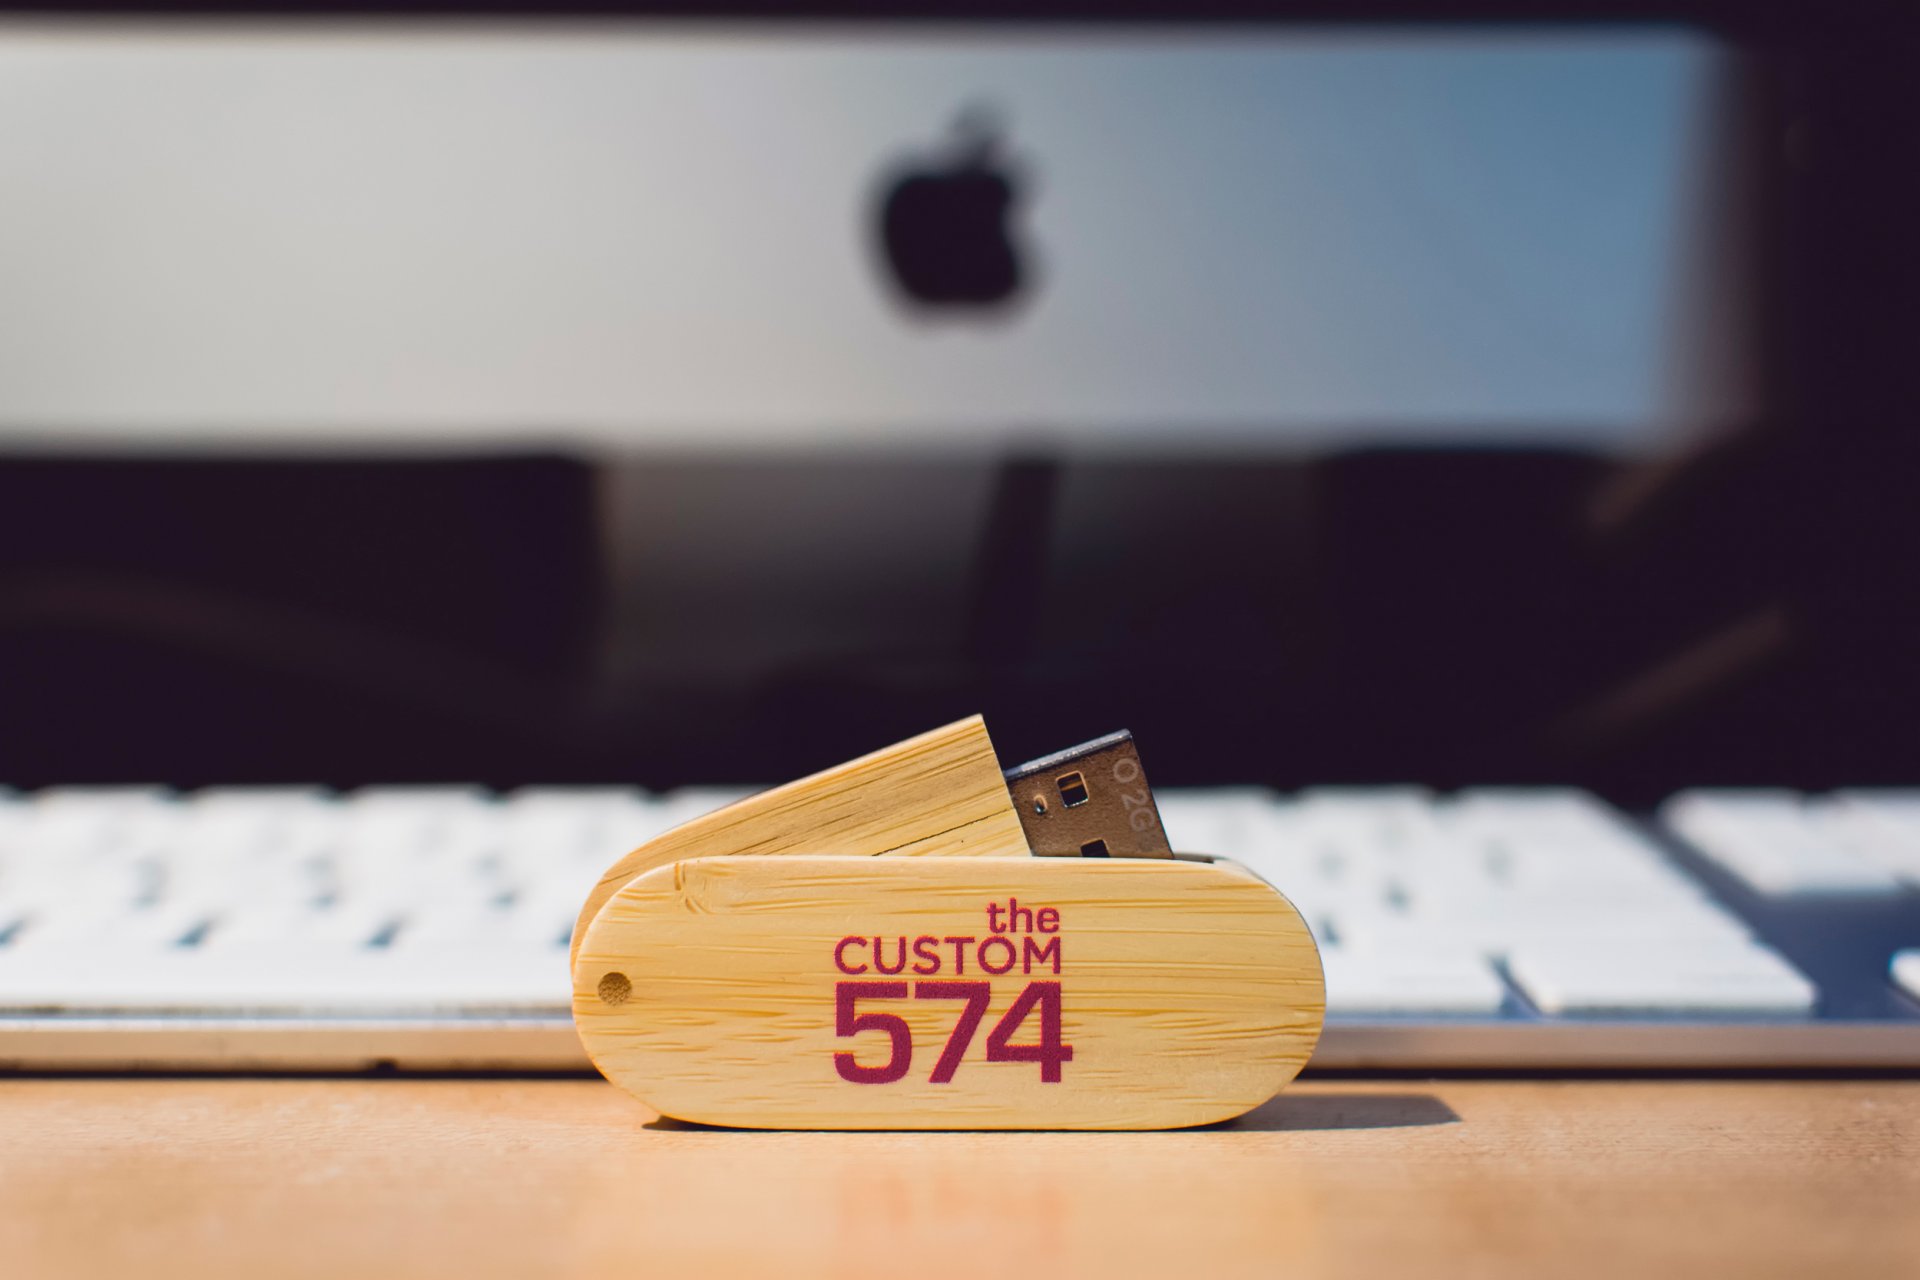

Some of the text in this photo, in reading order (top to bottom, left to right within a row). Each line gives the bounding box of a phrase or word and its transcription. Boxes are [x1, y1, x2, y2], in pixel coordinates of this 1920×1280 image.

[987, 898, 1060, 934] the
[834, 936, 1061, 975] CUSTOM
[834, 981, 1073, 1084] 574
